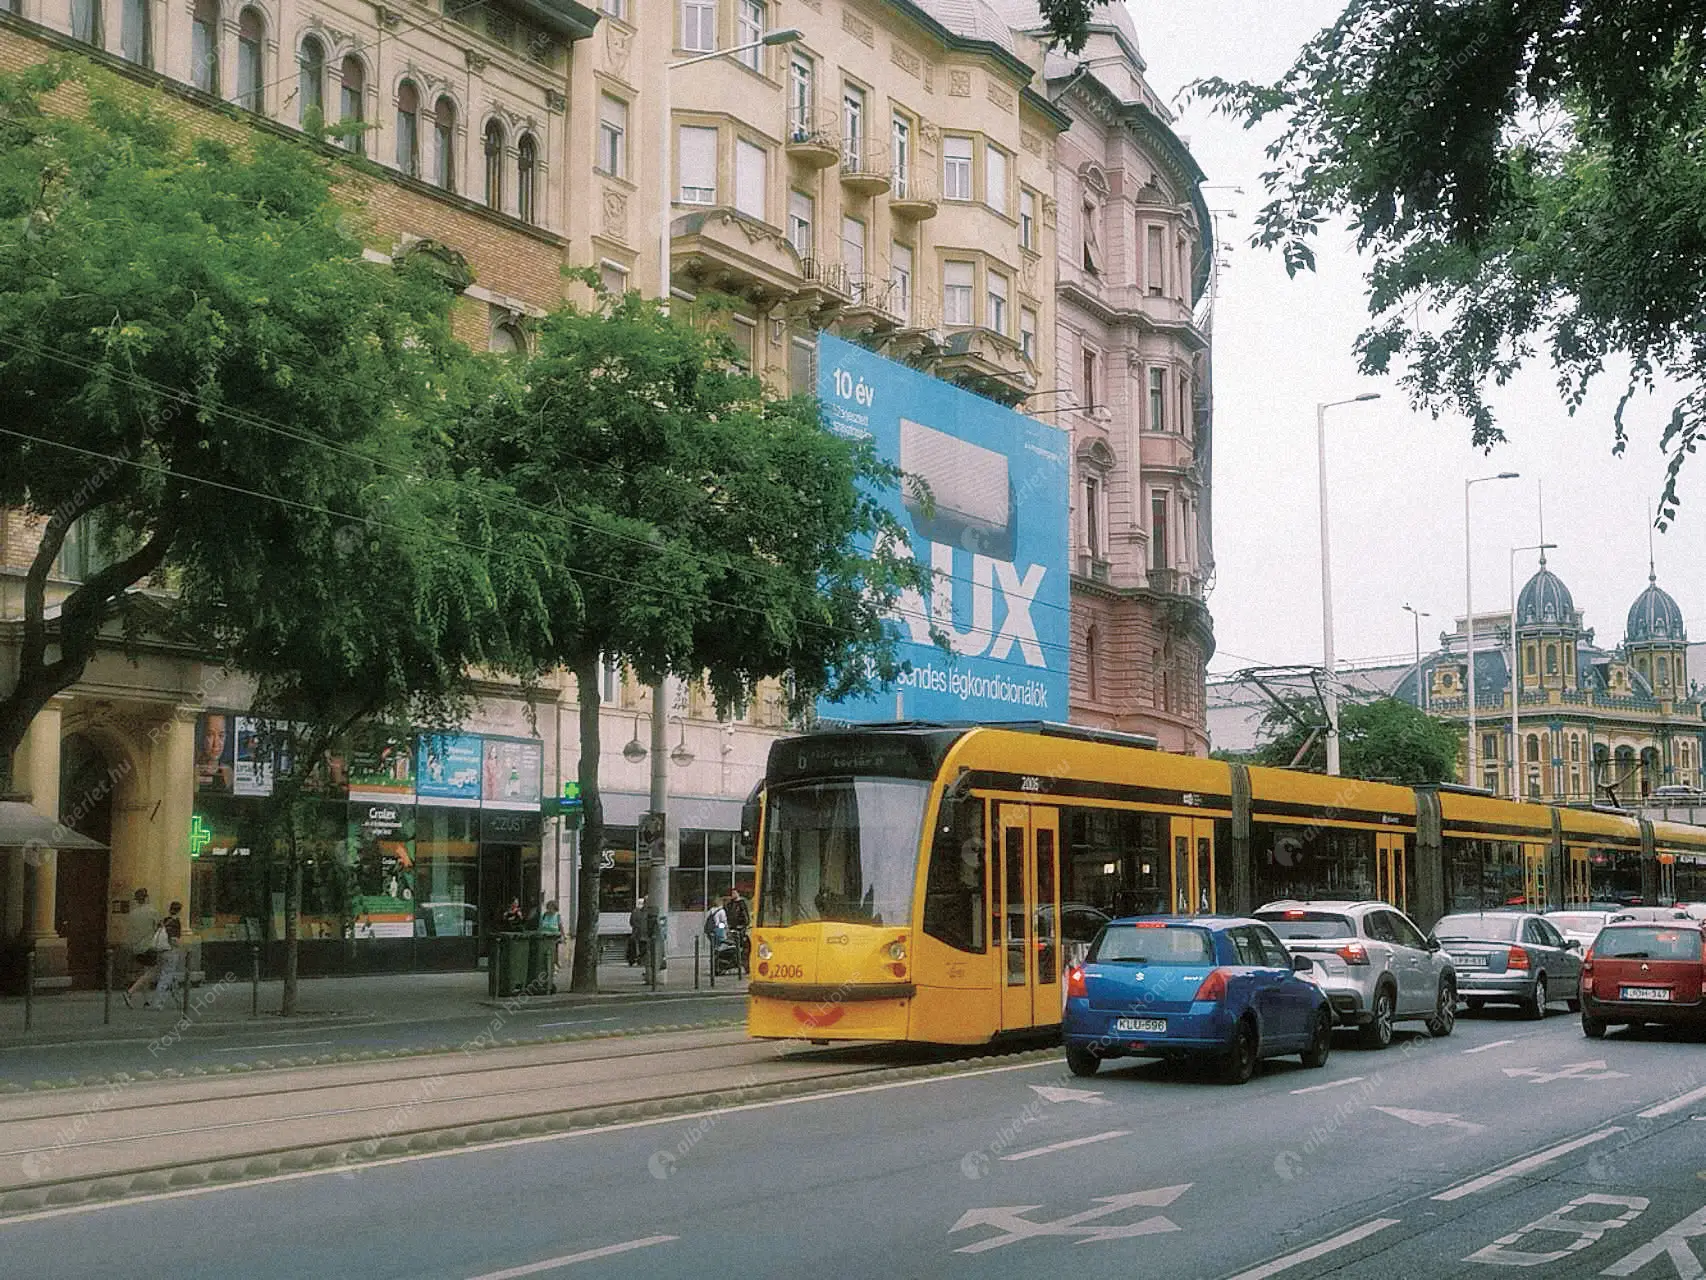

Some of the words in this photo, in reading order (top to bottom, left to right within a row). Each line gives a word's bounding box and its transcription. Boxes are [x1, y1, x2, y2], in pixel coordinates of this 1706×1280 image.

[833, 366, 853, 400] 10
[855, 375, 875, 408] év
[855, 529, 1048, 669] AUX
[949, 668, 1049, 709] légkondicionálók
[774, 964, 803, 978] 2006
